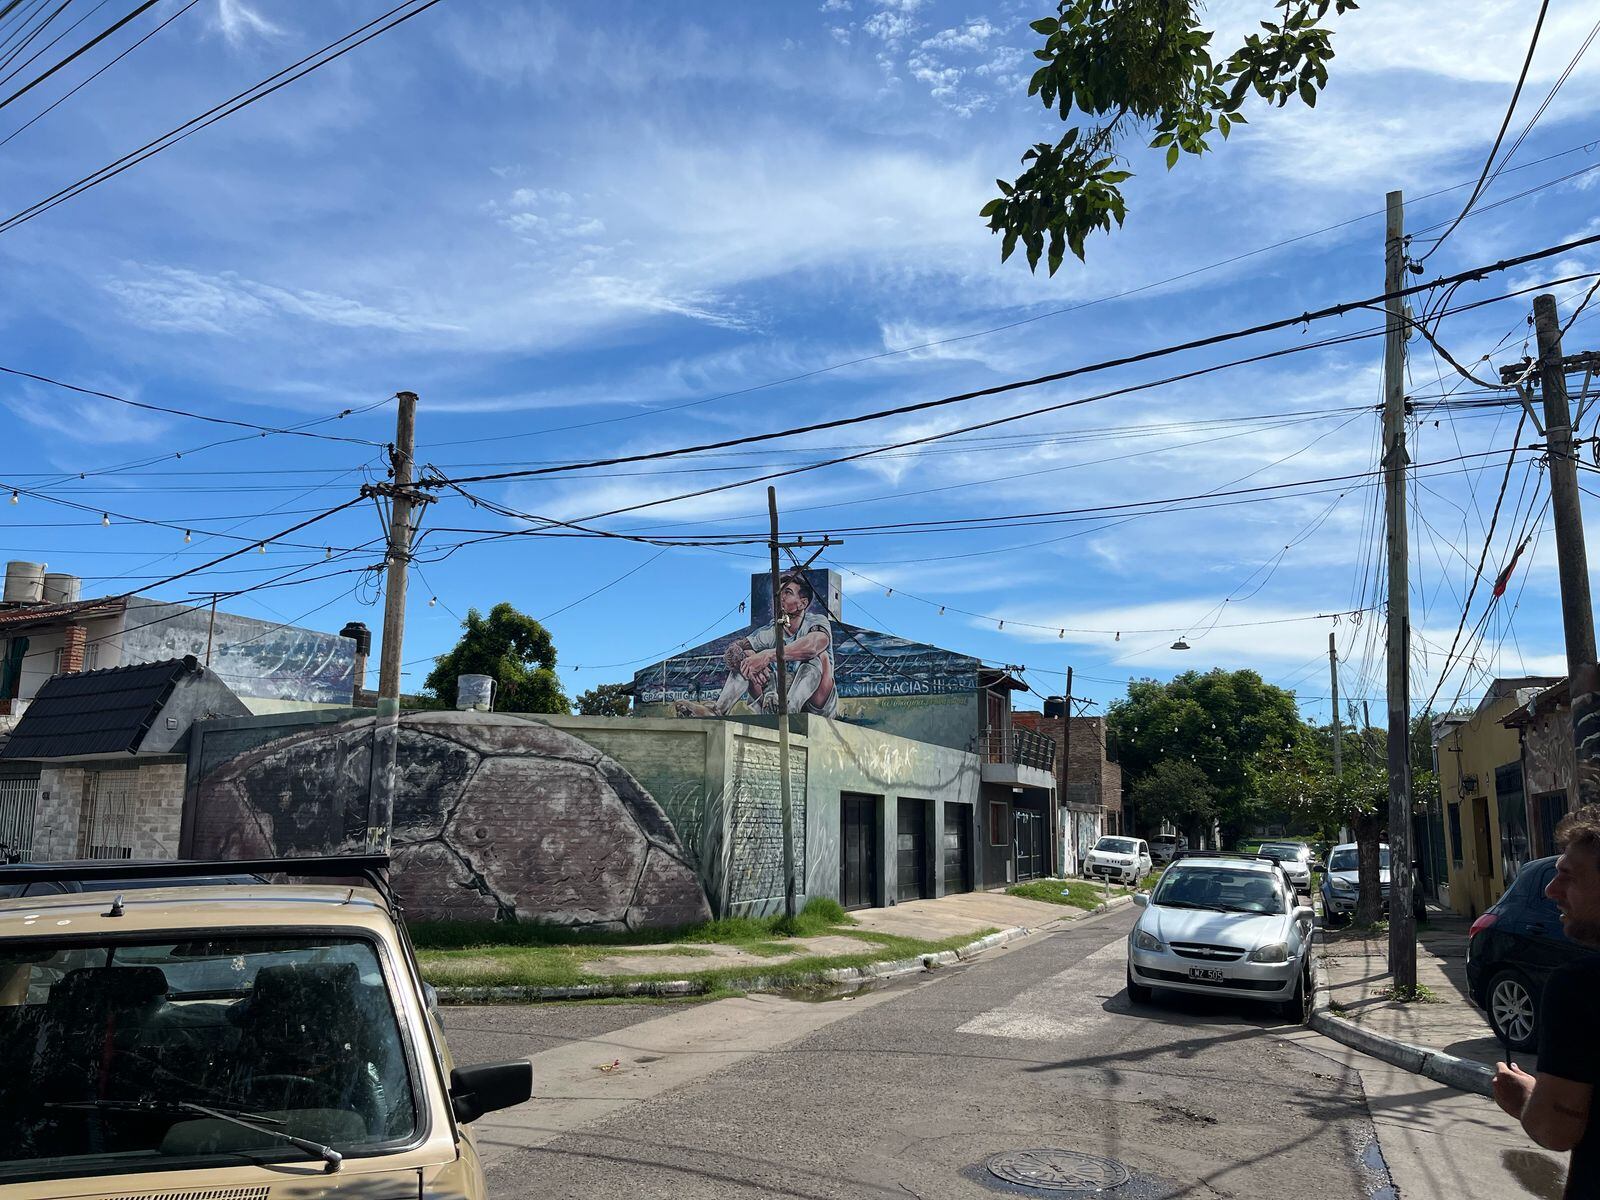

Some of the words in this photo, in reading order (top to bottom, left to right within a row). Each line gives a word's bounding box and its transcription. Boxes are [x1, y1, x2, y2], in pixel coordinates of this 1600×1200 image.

[875, 679, 929, 695] GRACIAS
[1190, 968, 1204, 978] LMZ
[1208, 970, 1222, 980] 505
